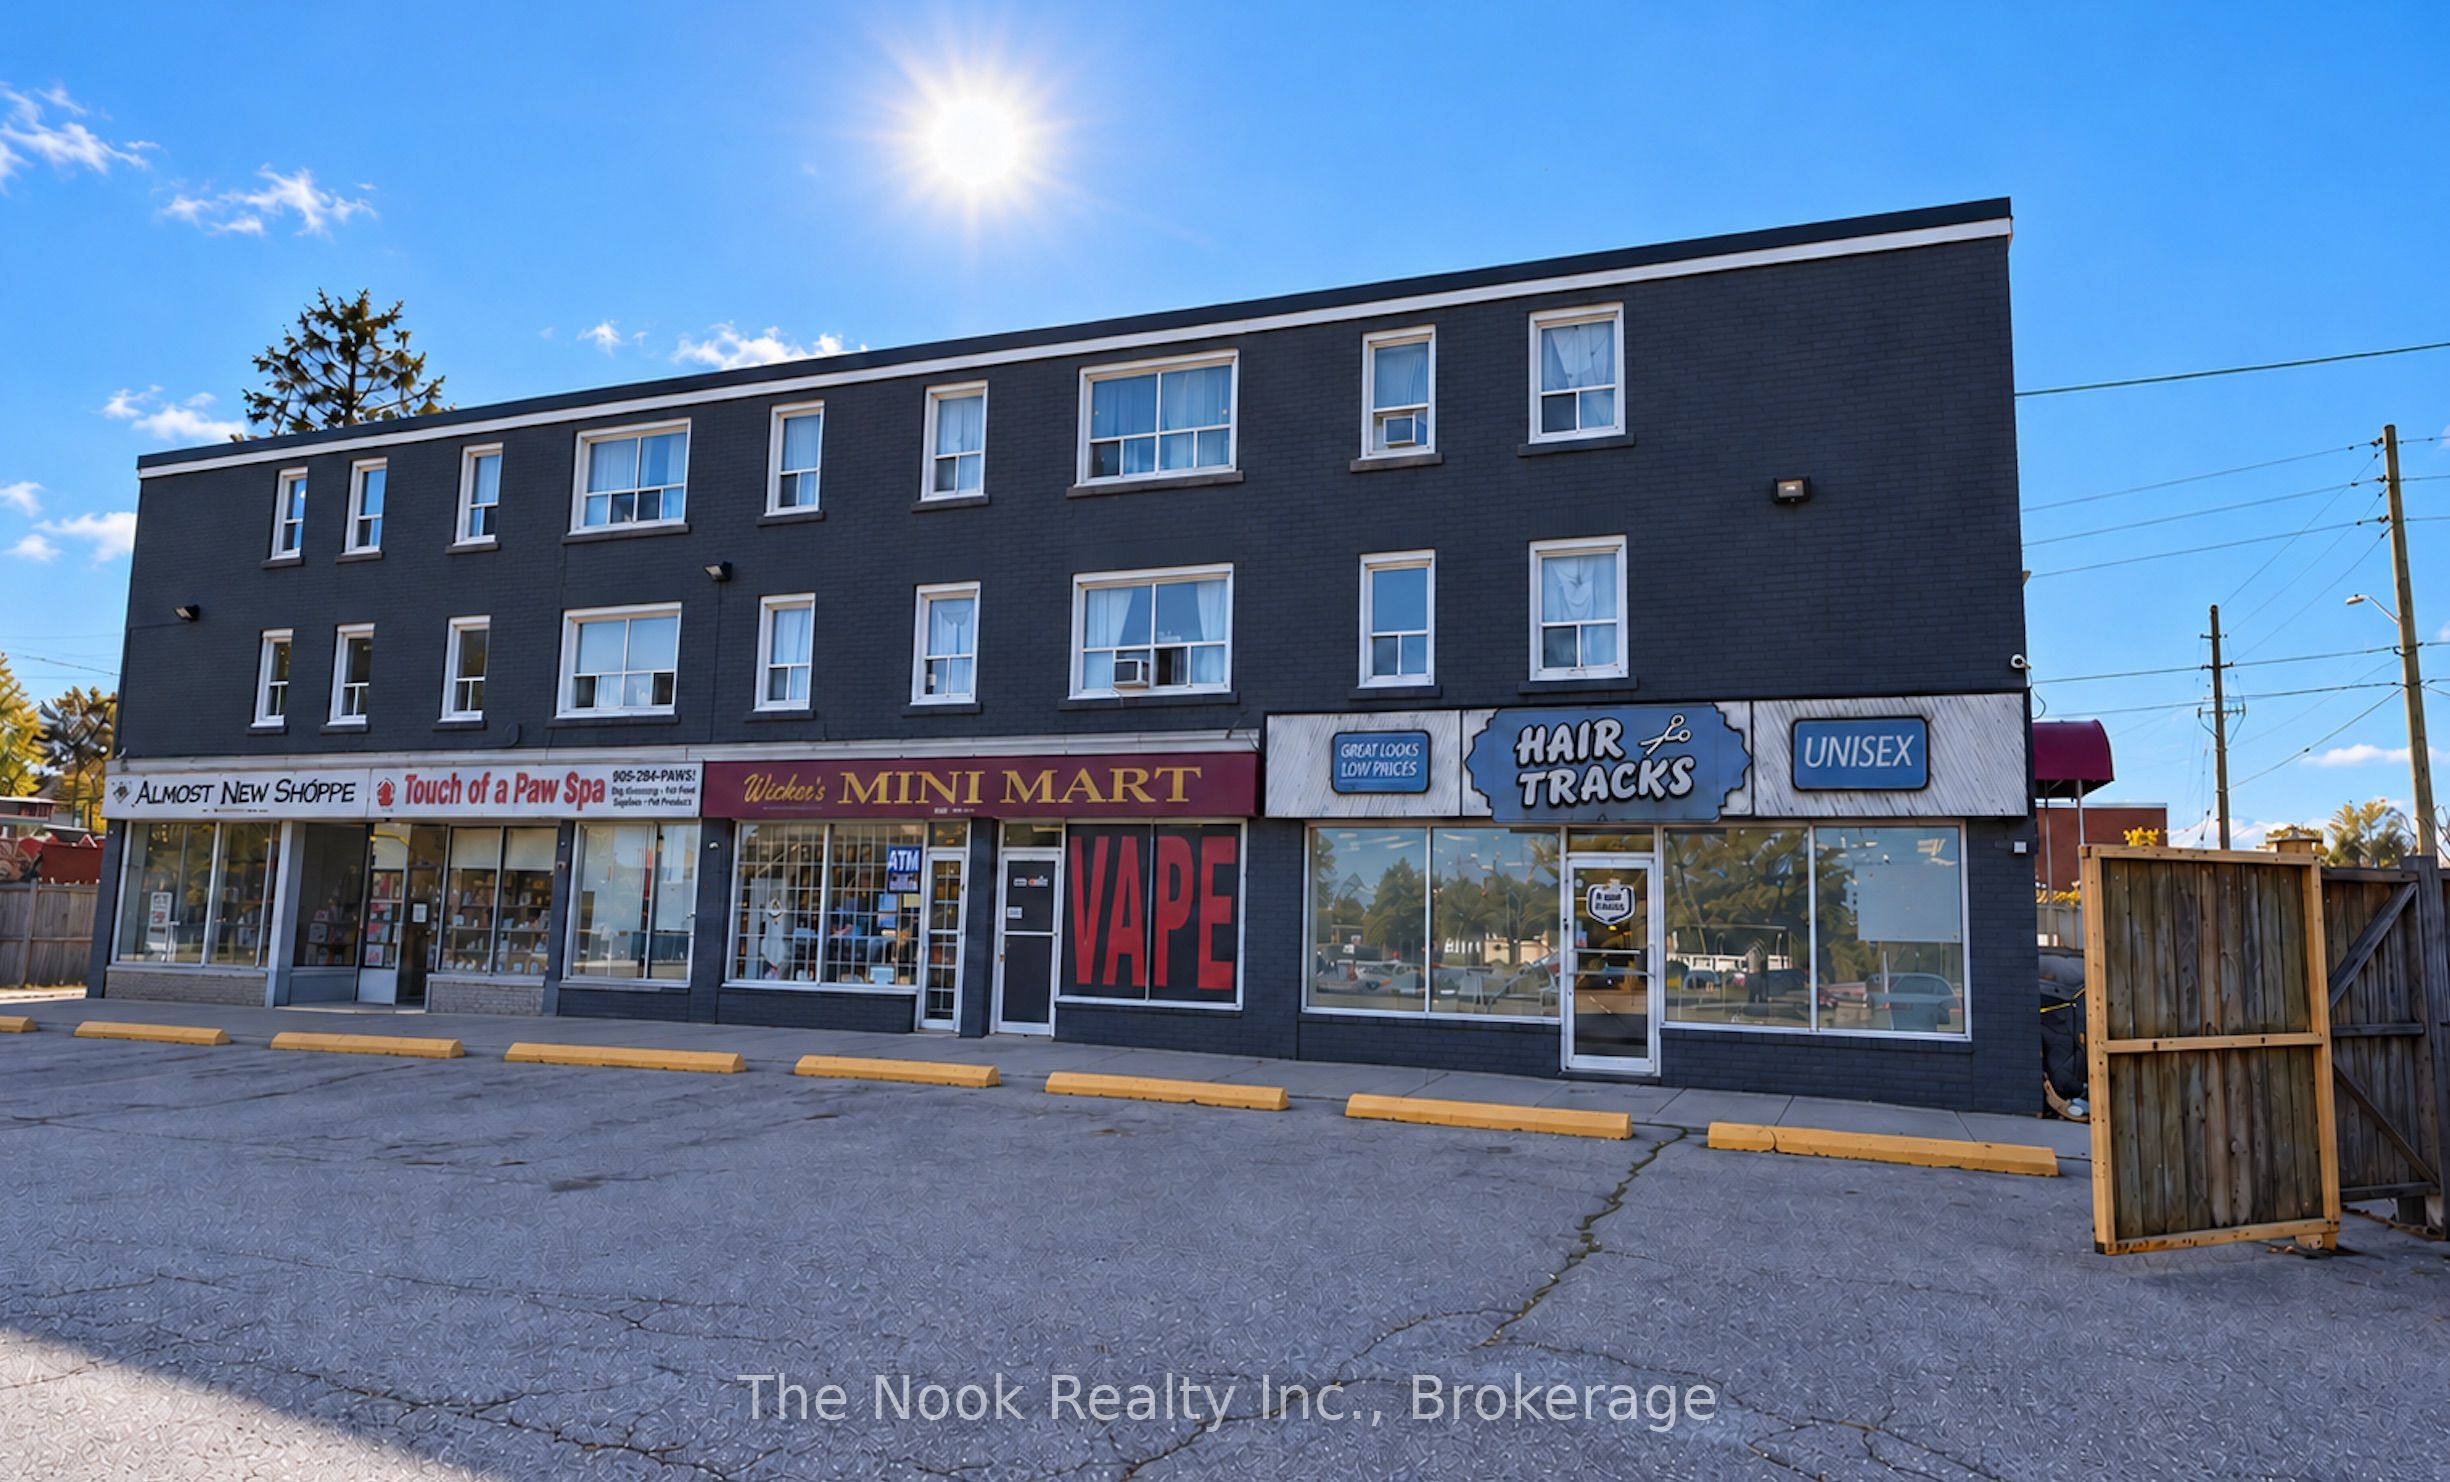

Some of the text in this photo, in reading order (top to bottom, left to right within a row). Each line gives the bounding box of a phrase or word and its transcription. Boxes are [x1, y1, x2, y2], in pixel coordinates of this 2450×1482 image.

[1341, 743, 1378, 758] GREAT
[1515, 717, 1625, 766] HAIR
[1804, 734, 1915, 768] UNISEX
[837, 770, 985, 804] MINI
[1000, 766, 1202, 804] MART
[1341, 761, 1371, 777] LOW
[1518, 755, 1697, 807] TRACKS
[131, 780, 215, 808] ALMOST
[219, 780, 269, 806] NEW
[404, 771, 606, 811] Touch of a Paw Spa
[887, 849, 920, 872] ATM
[1069, 835, 1237, 990] VAPE
